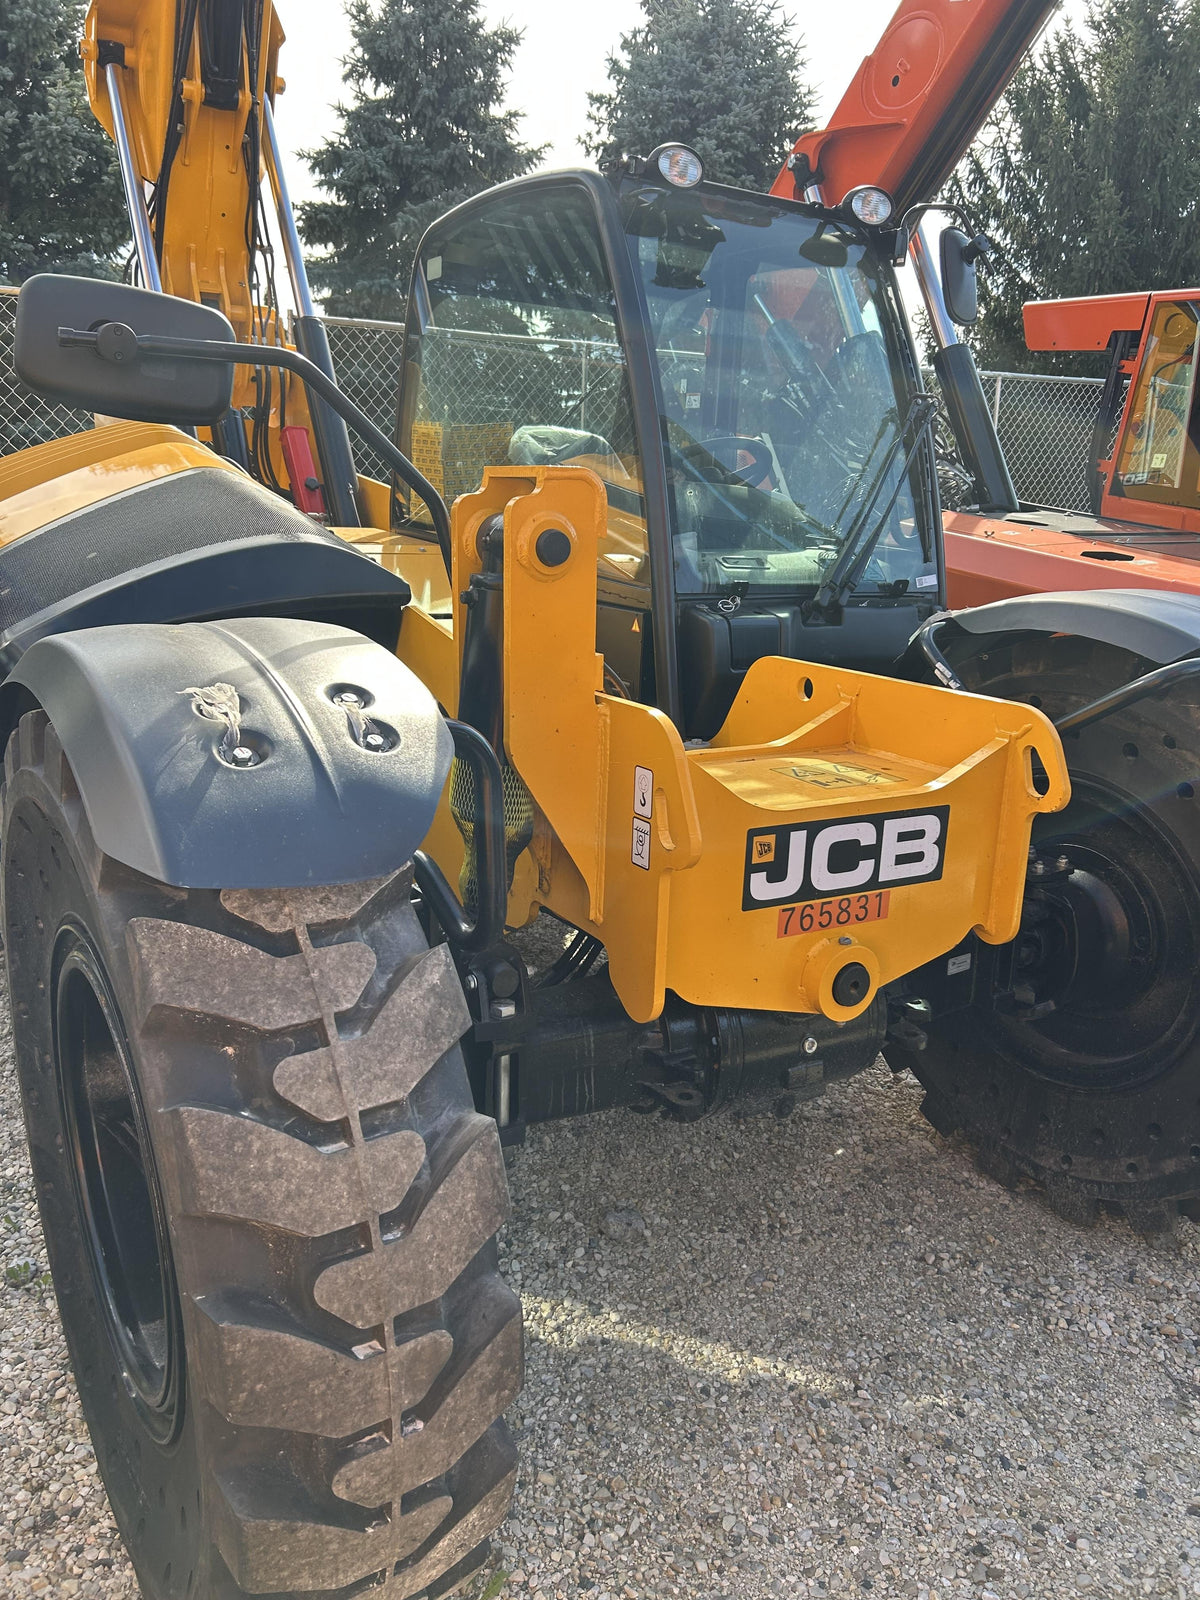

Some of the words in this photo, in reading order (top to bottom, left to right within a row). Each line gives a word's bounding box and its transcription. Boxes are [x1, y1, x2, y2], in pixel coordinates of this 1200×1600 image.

[749, 814, 942, 901] JCB
[757, 842, 772, 856] JCB
[781, 892, 884, 935] 765831
